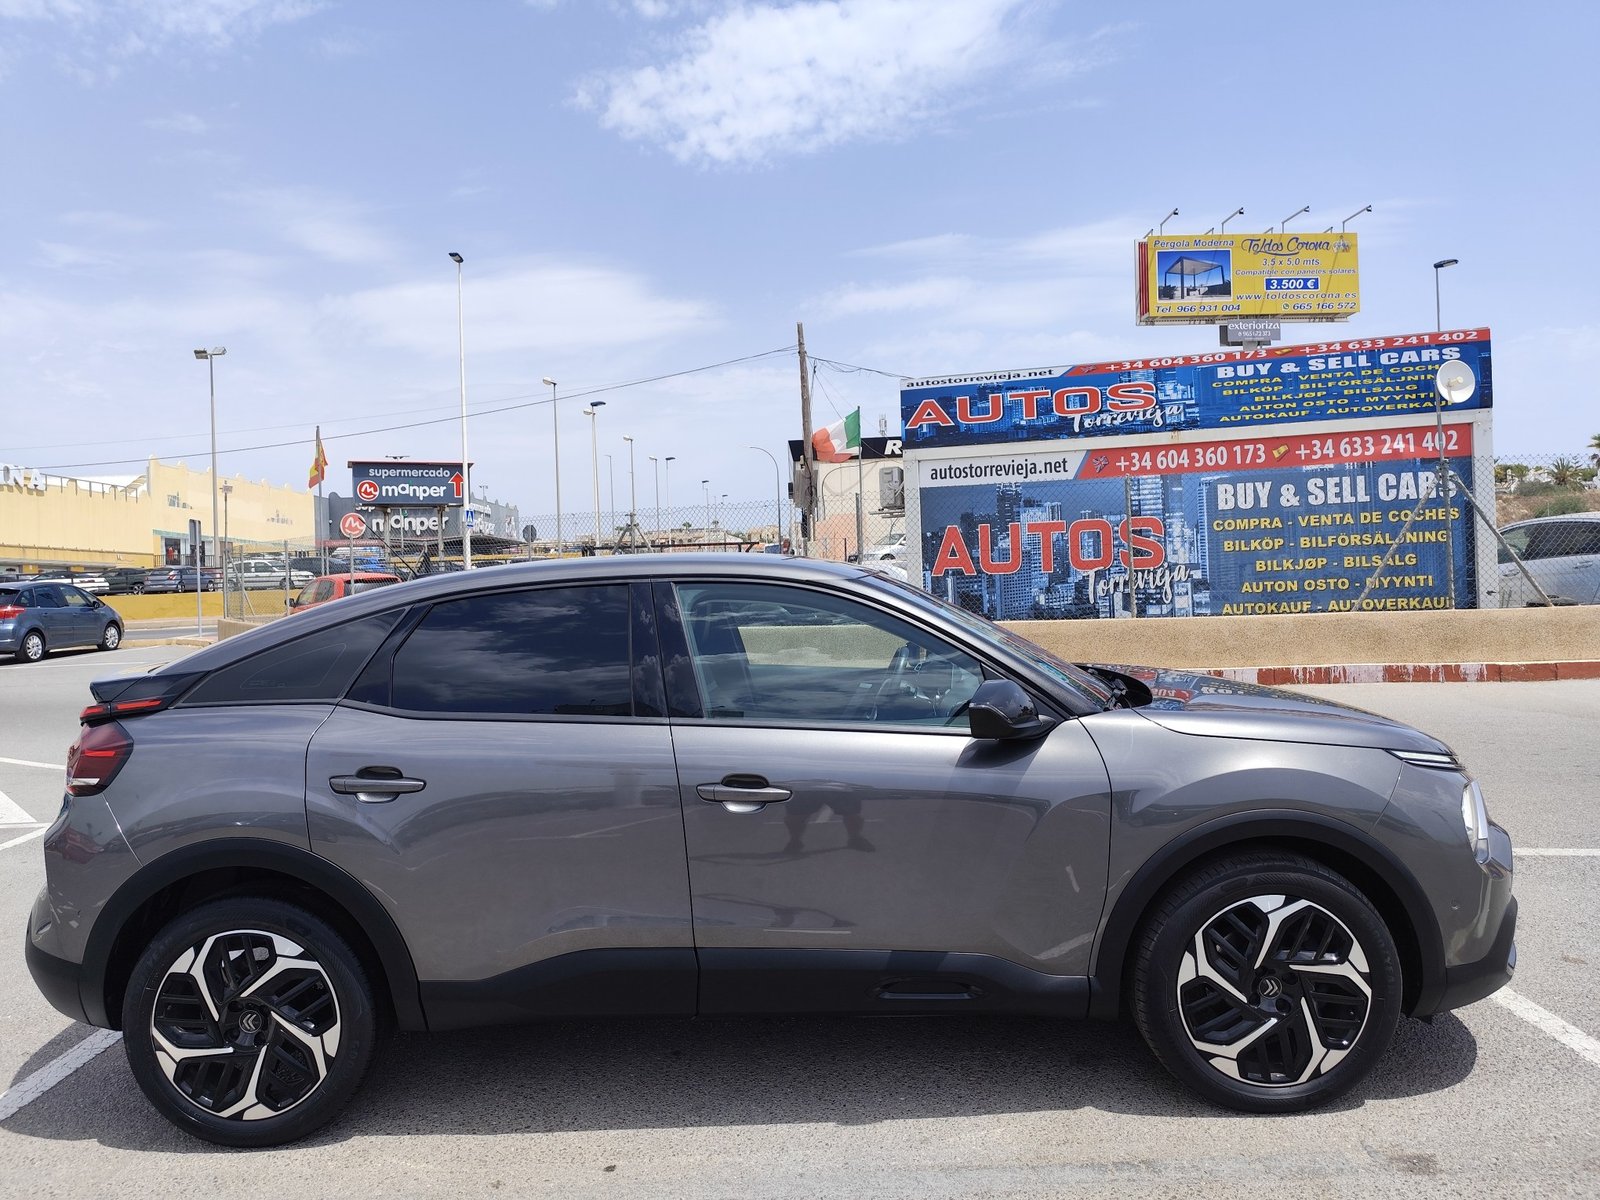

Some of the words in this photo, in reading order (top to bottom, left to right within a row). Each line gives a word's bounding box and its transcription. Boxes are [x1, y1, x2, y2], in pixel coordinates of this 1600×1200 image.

[1193, 239, 1234, 247] Moderna
[1241, 238, 1283, 255] Toldos
[1287, 237, 1330, 252] Corona
[1262, 258, 1276, 266] 3,5
[1286, 258, 1300, 266] 5,0
[1236, 268, 1279, 276] Compatible
[1297, 268, 1326, 276] paneles
[1270, 279, 1304, 290] 3.500
[1306, 279, 1316, 288] €
[1236, 292, 1357, 300] www.toldoscorona.es
[1155, 305, 1173, 314] Tel.
[1176, 304, 1197, 312] 966
[1199, 304, 1220, 312] 931
[1222, 304, 1241, 312] 004
[1316, 302, 1334, 310] 166
[1336, 302, 1357, 310] 572
[1228, 320, 1280, 330] exterioriza
[906, 368, 1054, 388] autostorrevieja.net
[1105, 360, 1144, 371] +34
[1149, 356, 1184, 366] 604
[1190, 352, 1226, 363] 360
[1232, 350, 1268, 360] 173
[1300, 342, 1342, 354] +34
[1348, 340, 1386, 350] 633
[1393, 335, 1430, 346] 241
[1438, 331, 1478, 342] 402
[1217, 362, 1272, 379] BUY
[1280, 362, 1300, 374] &
[1308, 354, 1372, 371] SELL
[1380, 347, 1461, 365] CARS
[1212, 377, 1282, 388] COMPRA
[1298, 371, 1354, 381] VENTA
[1361, 368, 1384, 376] DE
[1390, 364, 1440, 374] COCH
[1222, 386, 1284, 396] BILKÖP
[1300, 374, 1437, 390] BILFÖRSÄLJNIN
[1240, 402, 1297, 412] AUTON
[1302, 398, 1348, 407] OSTO
[1366, 392, 1434, 402] MYYNTI
[1254, 391, 1326, 402] BILKJØP
[1344, 384, 1418, 395] BILSALG
[904, 381, 1157, 429] AUTOS
[1067, 404, 1182, 433] Torrevieja
[1220, 410, 1310, 422] AUTOKAUF
[930, 457, 1068, 480] autostorrevieja.net
[1115, 452, 1152, 472] +34
[1156, 449, 1190, 469] 604
[1194, 446, 1228, 467] 360
[1233, 444, 1266, 464] 173
[1295, 438, 1334, 461] +34
[1340, 436, 1374, 457] 633
[1381, 432, 1416, 455] 241
[1422, 430, 1458, 452] 402
[368, 468, 450, 479] supermercado
[382, 483, 446, 500] manper
[1217, 481, 1273, 510] BUY
[1280, 484, 1300, 507] &
[1307, 474, 1370, 504] SELL
[1212, 516, 1282, 532] COMPRA
[1298, 513, 1354, 528] VENTA
[1360, 511, 1382, 524] DE
[1388, 507, 1460, 522] COCHES
[932, 516, 1166, 577] AUTOS
[1224, 534, 1284, 552] BILKÖP
[1256, 556, 1328, 572] BILKJØP
[1086, 562, 1192, 604] Torrevieja
[1242, 579, 1298, 594] AUTON
[1304, 578, 1350, 591] OSTO
[1222, 600, 1312, 616] AUTOKAUF
